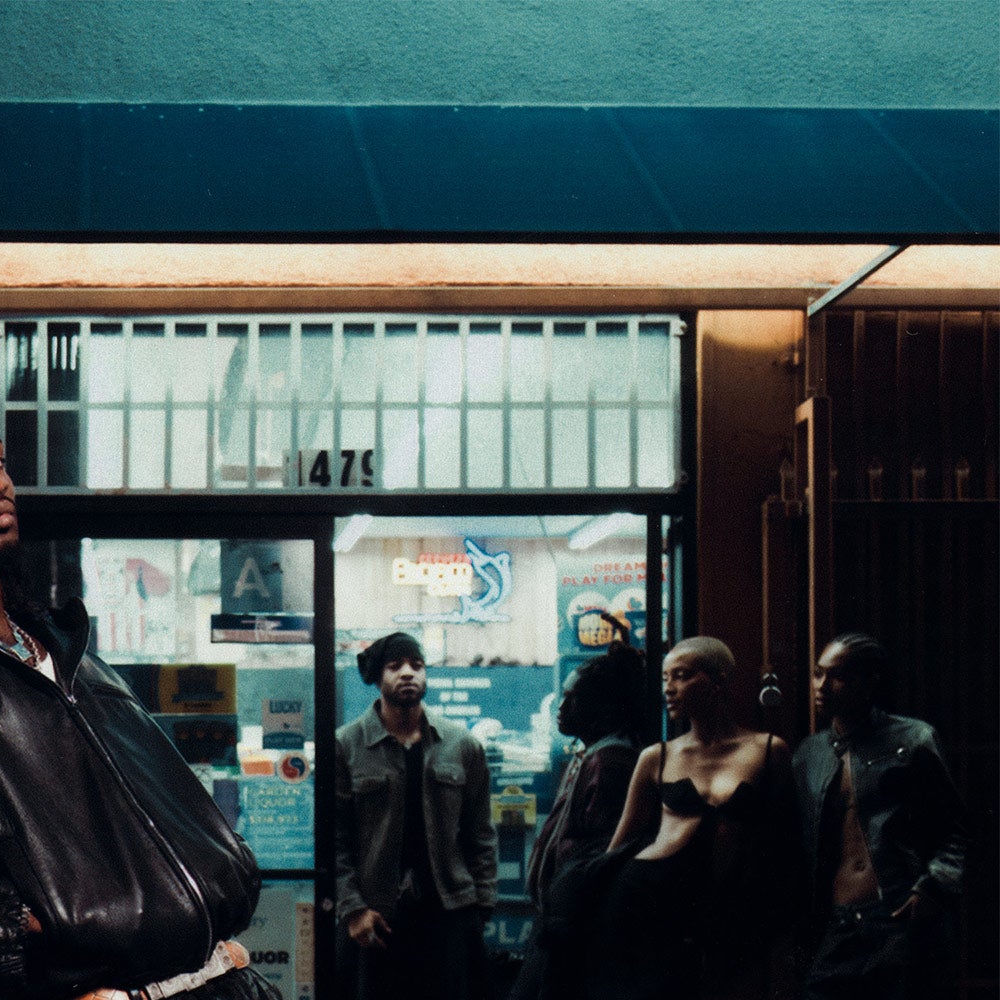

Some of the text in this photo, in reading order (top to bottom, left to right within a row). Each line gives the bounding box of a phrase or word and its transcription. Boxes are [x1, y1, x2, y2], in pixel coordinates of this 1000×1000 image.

[232, 557, 271, 599] A
[561, 575, 599, 586] PLAY
[603, 573, 632, 584] FOR
[269, 700, 302, 713] LUCKY
